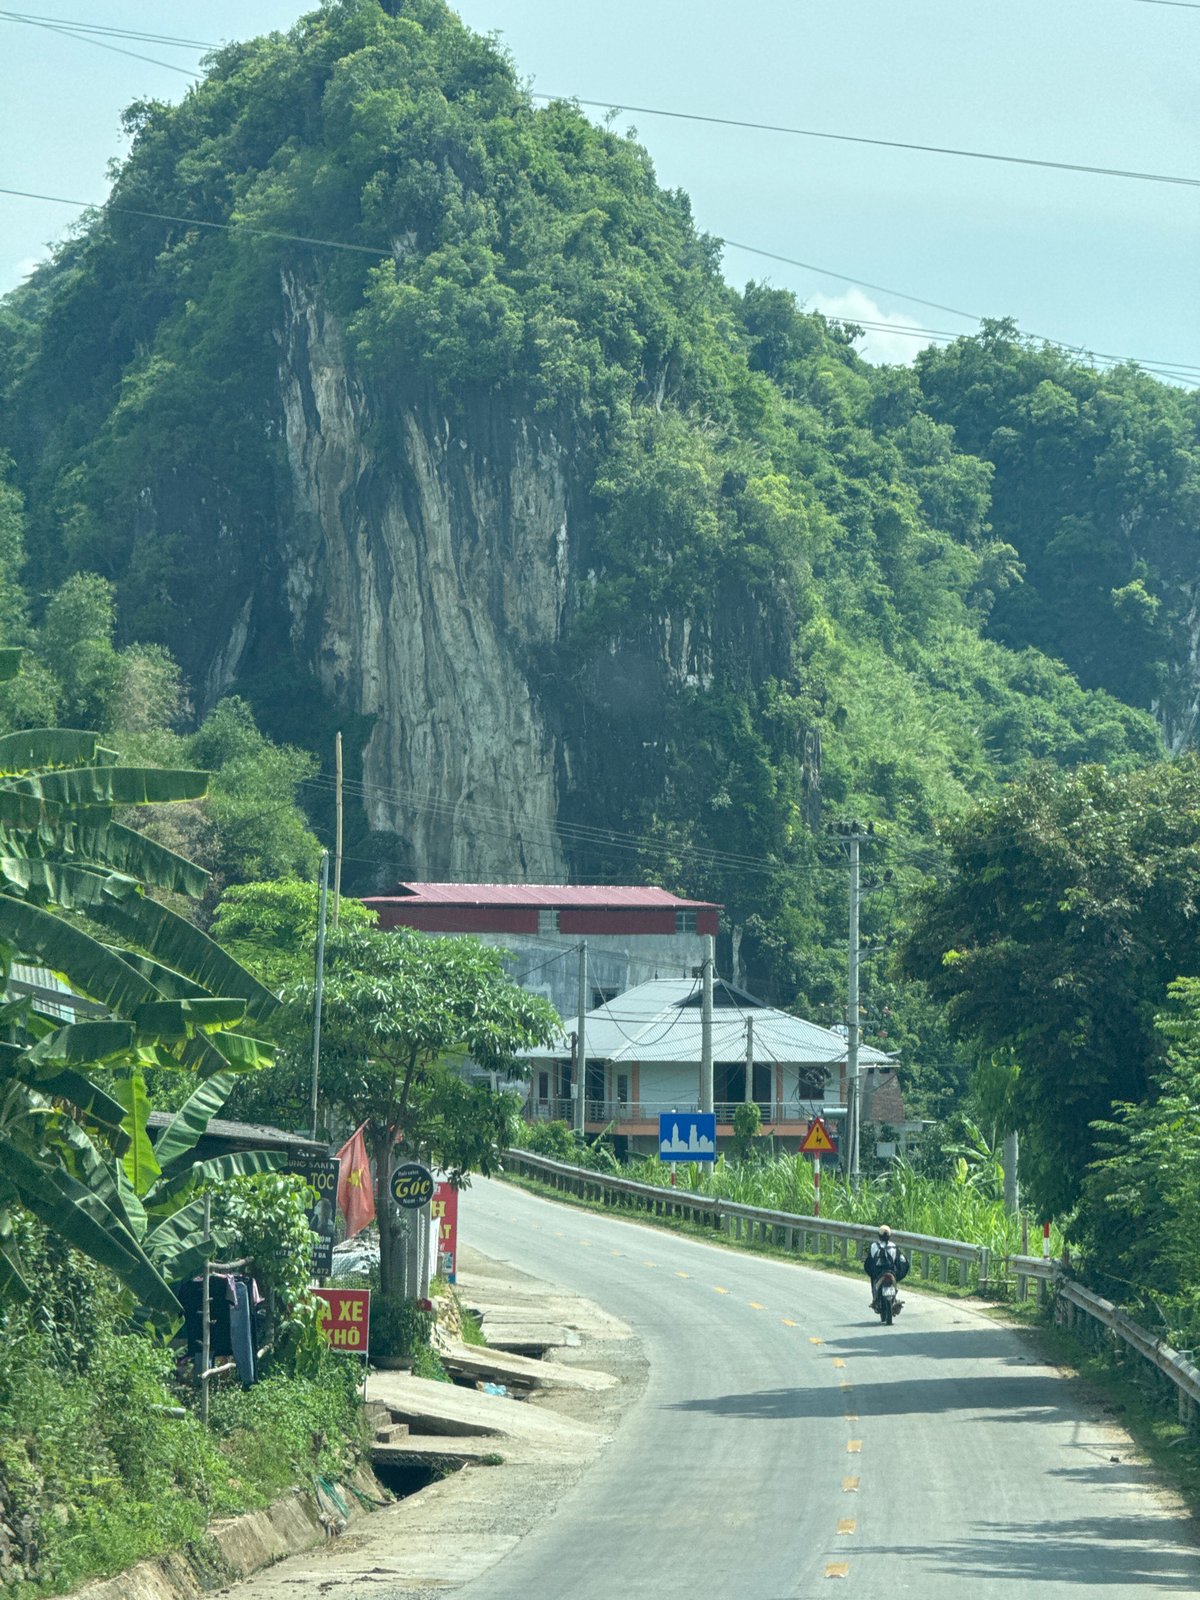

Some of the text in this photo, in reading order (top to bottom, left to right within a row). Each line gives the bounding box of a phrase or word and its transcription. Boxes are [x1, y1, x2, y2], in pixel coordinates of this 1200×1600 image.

[311, 1170, 335, 1190] TÓC
[321, 1300, 364, 1322] A XE
